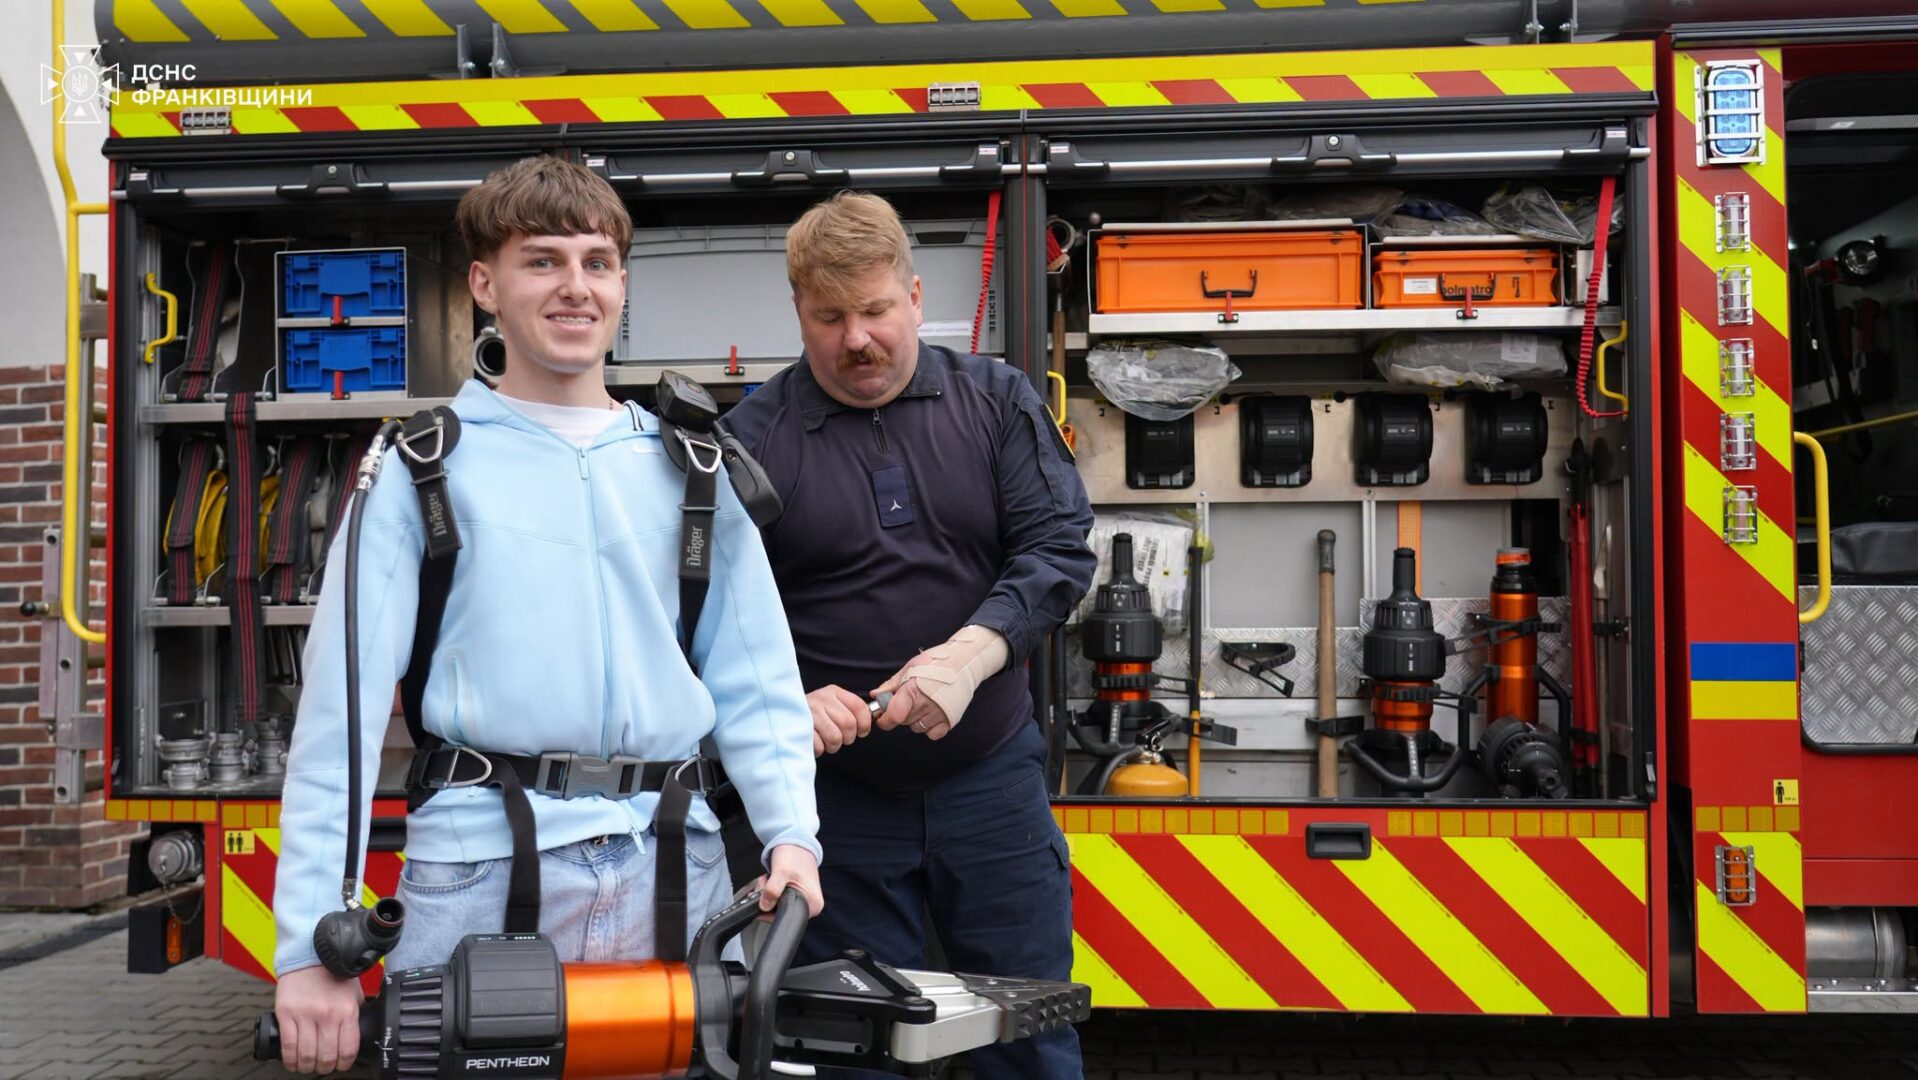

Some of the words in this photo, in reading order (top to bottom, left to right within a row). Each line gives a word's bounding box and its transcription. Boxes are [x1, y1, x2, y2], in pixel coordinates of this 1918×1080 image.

[428, 492, 448, 538] Dräger
[686, 525, 705, 568] Dräger
[465, 1055, 551, 1070] PENTHEON
